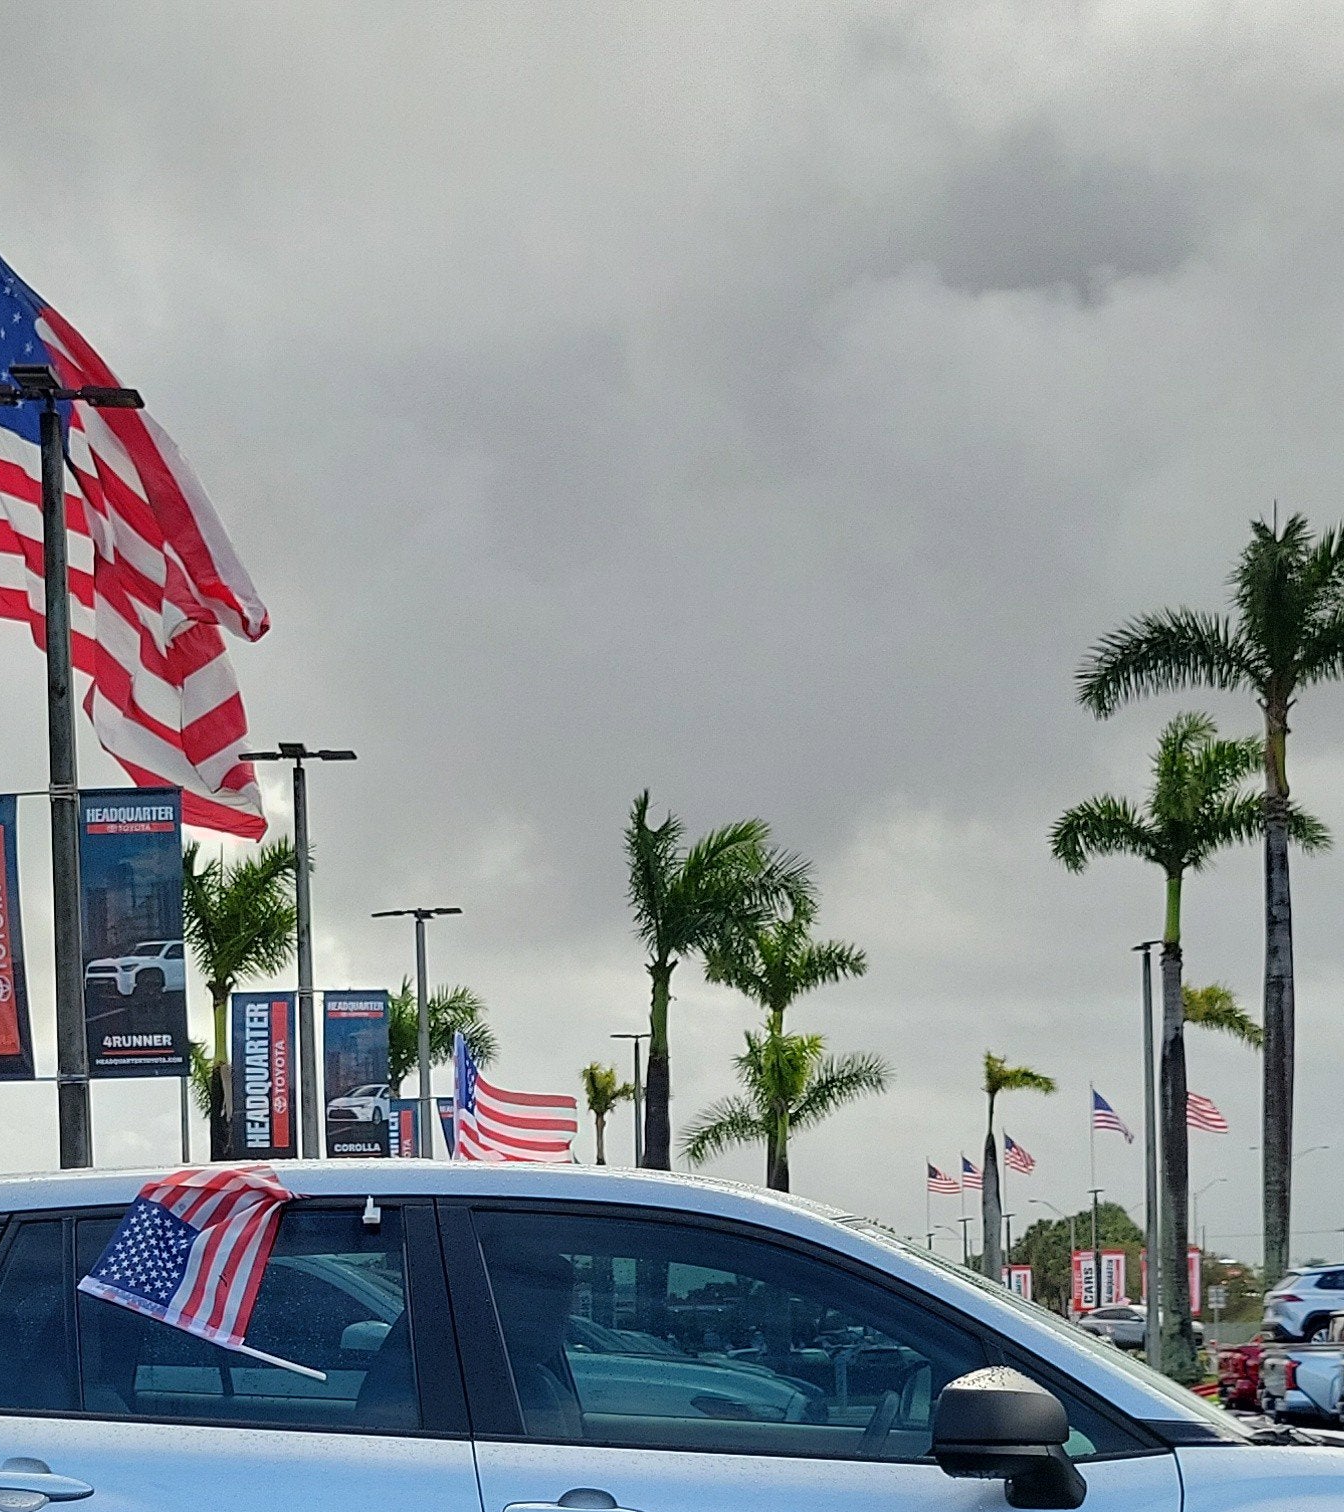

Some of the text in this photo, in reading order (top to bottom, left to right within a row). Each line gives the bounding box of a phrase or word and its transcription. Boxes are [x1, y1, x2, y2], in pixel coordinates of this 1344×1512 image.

[86, 806, 174, 824] HEADQUARTER
[102, 1034, 173, 1048] 4RUNNER
[245, 1002, 272, 1149] HEADQUARTER
[274, 1040, 286, 1095] TOYOTA
[334, 1142, 382, 1153] COROLLA
[1083, 1267, 1094, 1304] CARS
